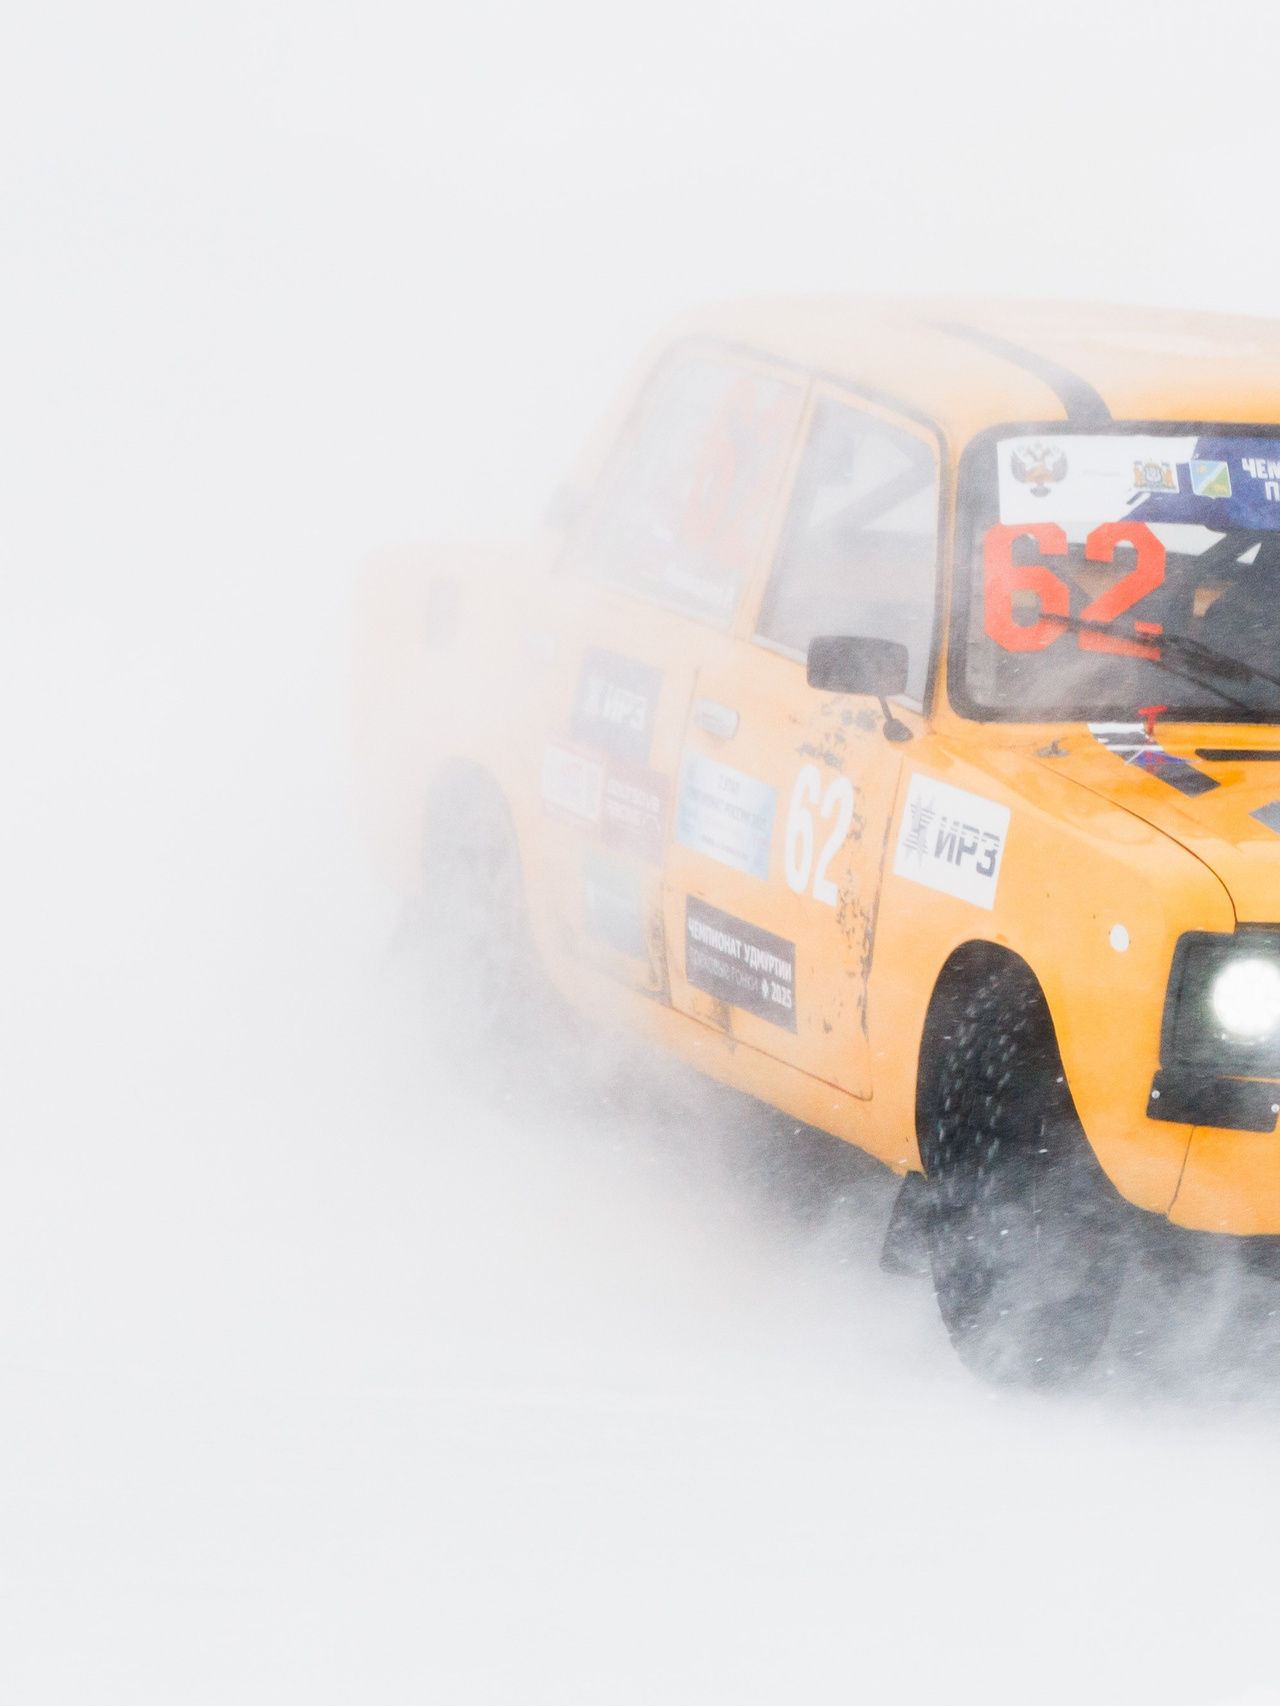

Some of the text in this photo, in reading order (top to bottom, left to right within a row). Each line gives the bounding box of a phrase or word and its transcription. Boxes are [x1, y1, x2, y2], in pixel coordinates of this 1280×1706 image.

[983, 522, 1166, 661] 62
[785, 763, 854, 908] 62
[934, 815, 1000, 878] ИРЗ
[687, 917, 792, 983] ЧЕМПИОНАТ УДМУРТИИ
[770, 979, 792, 1009] 2025
